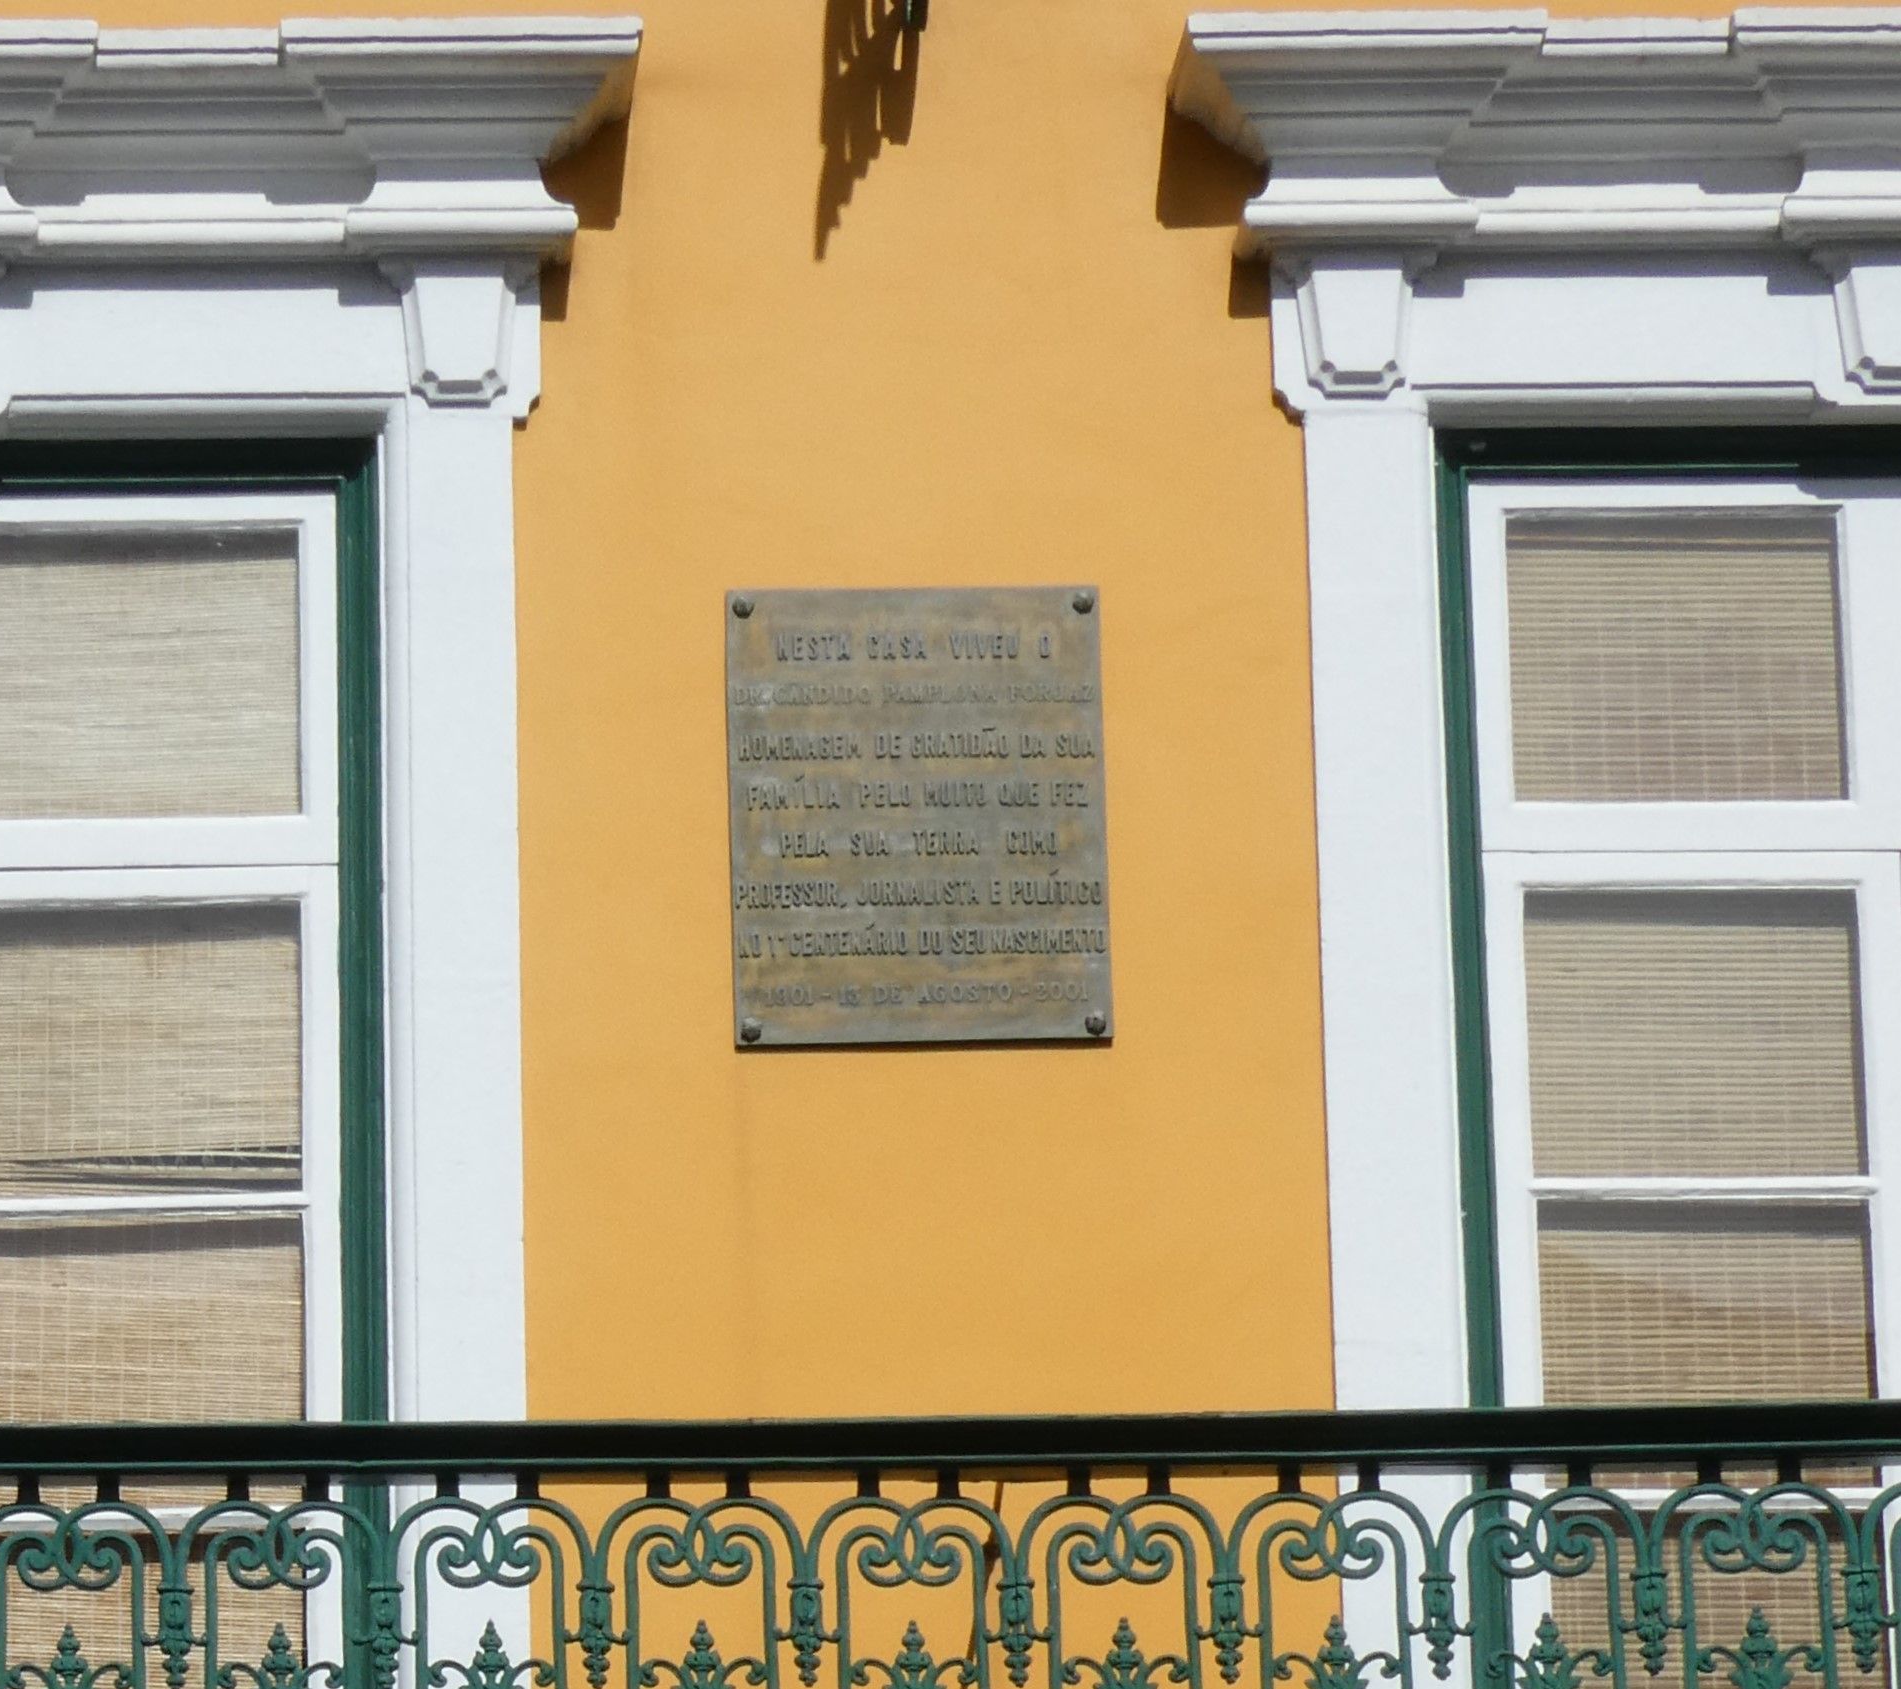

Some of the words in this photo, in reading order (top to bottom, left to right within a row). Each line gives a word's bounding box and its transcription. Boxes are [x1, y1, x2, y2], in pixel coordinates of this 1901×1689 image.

[777, 634, 850, 661] NESTA
[868, 633, 927, 660] CASA
[950, 632, 1020, 659] VIVEU
[1039, 631, 1051, 659] O
[882, 683, 997, 704] PAMPLONA
[1008, 683, 1093, 703] FORJAZ
[738, 735, 861, 761] HOMENAGEM
[875, 734, 901, 759] DE
[911, 728, 1009, 759] GRATIDÃO
[1020, 734, 1046, 758] DA
[1056, 733, 1095, 758] SUA
[747, 775, 840, 811] FAMÍLIA
[861, 782, 911, 808] PELO
[924, 781, 987, 807] MUITO
[999, 781, 1040, 807] QUE
[1051, 781, 1088, 807] FEZ
[780, 832, 829, 858] PELA
[851, 832, 890, 856] SUA
[912, 831, 979, 855] TERRA
[1006, 830, 1057, 855] COMO
[735, 880, 847, 909] PROFESSOR,
[856, 879, 979, 906] JORNALISTA
[990, 880, 1001, 905] E
[1010, 869, 1102, 905] POLÍTICO
[738, 931, 761, 958] NO
[790, 922, 908, 957] CENTENÁRIO
[918, 929, 943, 955] DO
[950, 928, 986, 954] SEU
[990, 927, 1106, 954] NASCIMENTO
[873, 983, 903, 1004] DE
[917, 981, 1013, 1004] AGOSTO
[1034, 980, 1089, 1002] 2001
